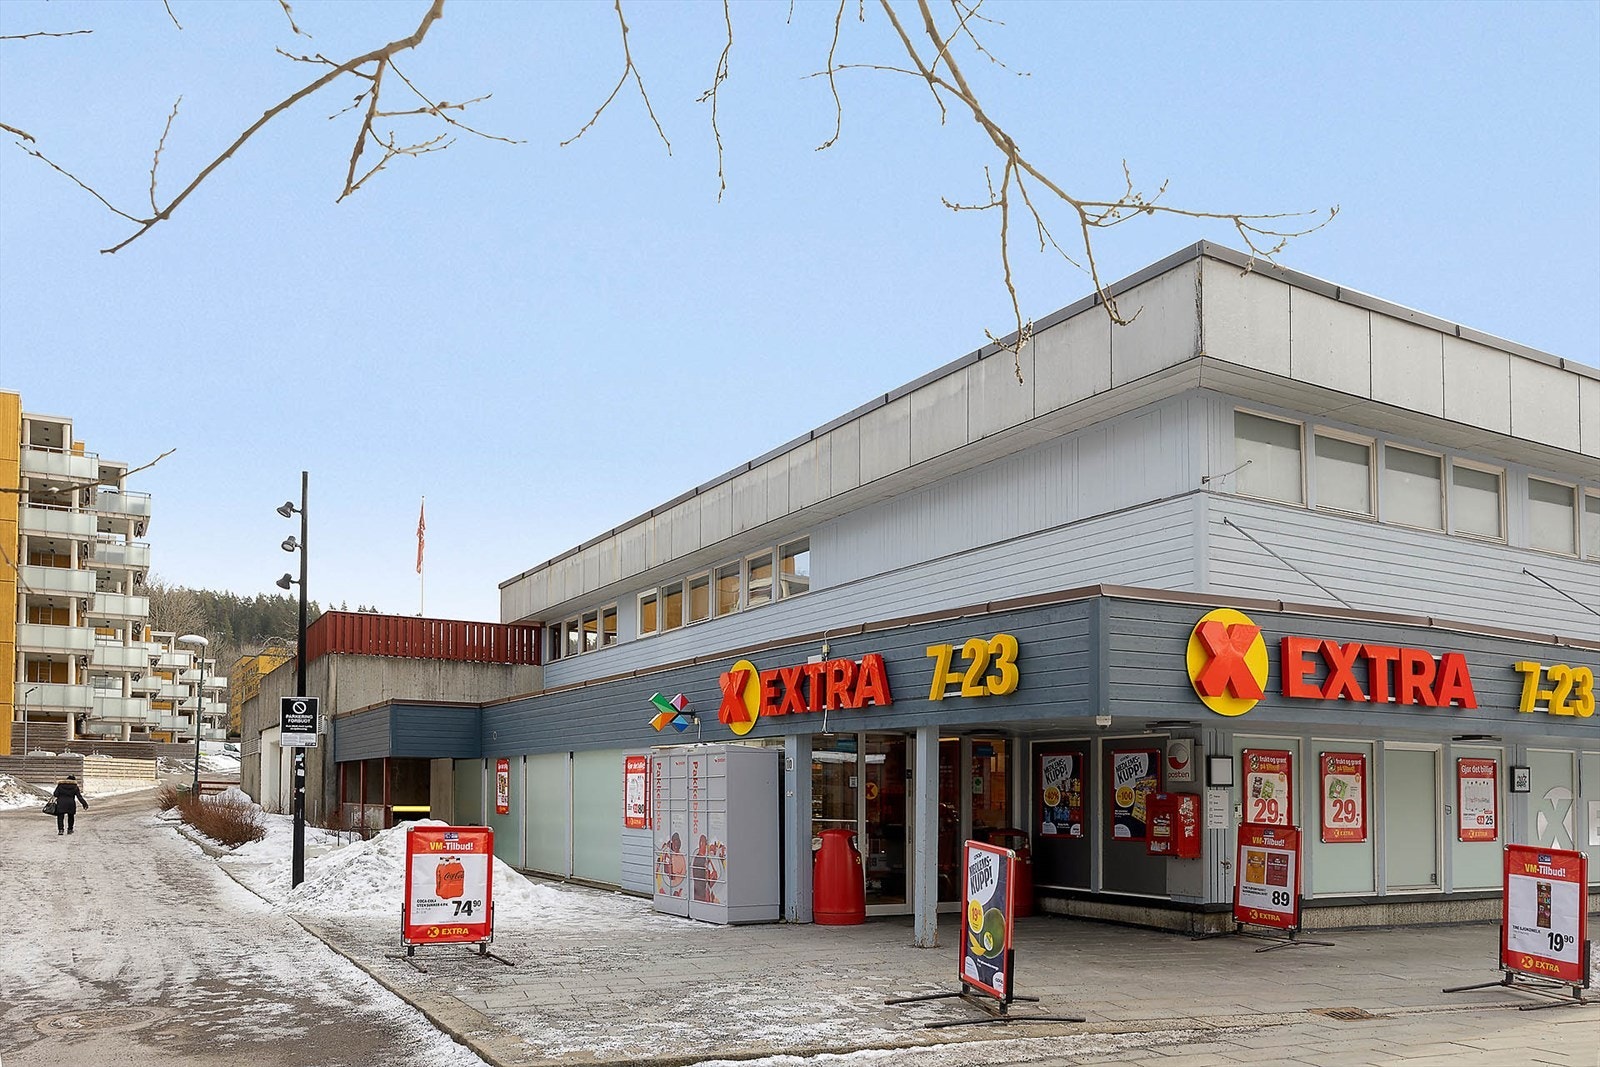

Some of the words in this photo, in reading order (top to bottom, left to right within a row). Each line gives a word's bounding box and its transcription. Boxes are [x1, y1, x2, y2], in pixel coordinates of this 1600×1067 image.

[927, 633, 1020, 701] 7-23
[1281, 636, 1478, 709] EXTRA
[760, 654, 892, 717] EXTRA
[1515, 661, 1596, 718] 7-23
[1117, 762, 1144, 784] KUPP!
[430, 842, 474, 850] VM-Tilbud!
[1252, 836, 1285, 847] VM-Tilbud!
[1524, 863, 1566, 877] VM-Tilbud!
[970, 866, 993, 895] KUPP!
[1272, 890, 1290, 907] 89
[452, 900, 473, 916] 74
[1260, 912, 1281, 921] EXTRA
[1548, 932, 1564, 952] 19
[1564, 935, 1575, 944] 90
[1536, 961, 1560, 973] EXTRA
